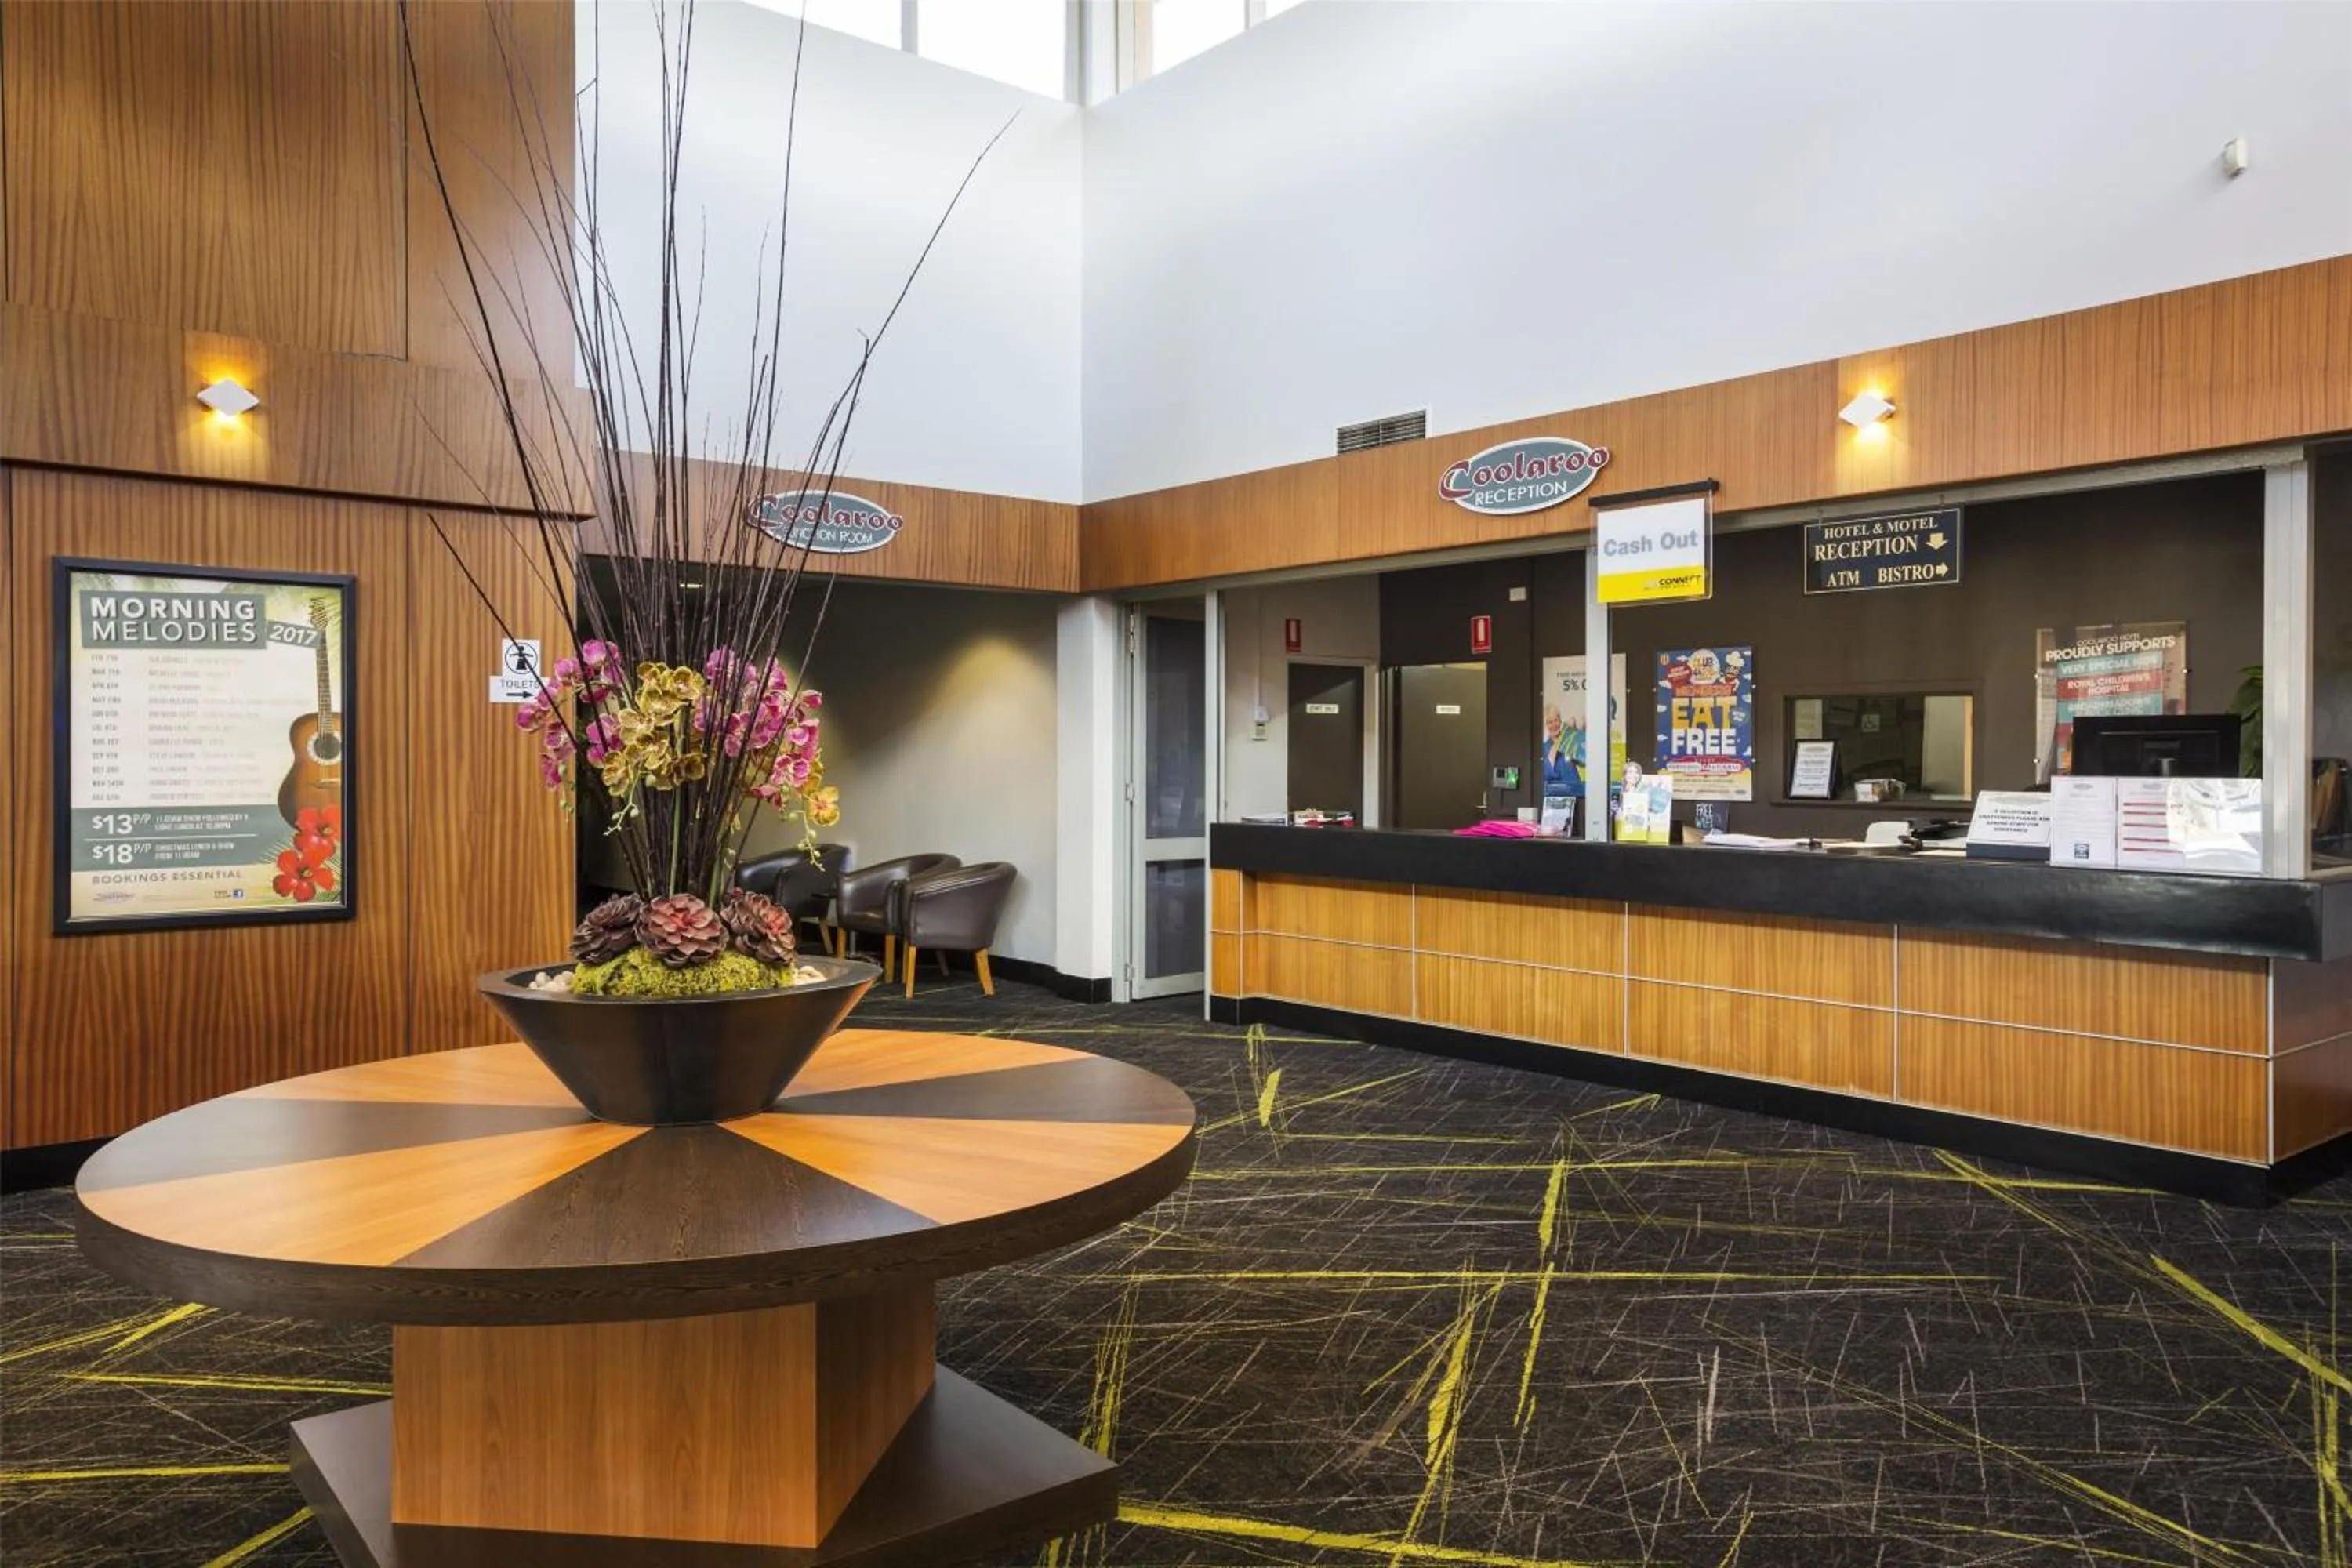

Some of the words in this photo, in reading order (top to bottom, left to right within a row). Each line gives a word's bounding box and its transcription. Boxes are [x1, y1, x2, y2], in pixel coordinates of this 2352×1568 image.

[1439, 446, 1609, 500] Coolaroo
[1475, 480, 1567, 506] RECEPTION
[840, 531, 873, 543] ROOM
[1824, 524, 1870, 539] HOTEL
[1872, 522, 1883, 534] &
[1887, 517, 1938, 533] MOTEL
[1603, 535, 1653, 557] Cash
[1660, 529, 1699, 550] Out
[1814, 535, 1918, 561] RECEPTION
[1827, 570, 1860, 587] ATM
[1878, 564, 1934, 583] BISTRO
[90, 597, 256, 620] MORNING
[92, 621, 257, 644] MELODIES
[269, 625, 318, 645] 2017
[2045, 644, 2103, 662] PROUDLY
[2107, 635, 2176, 655] SUPPORTS
[501, 679, 540, 688] TOILETS
[1671, 696, 1737, 729] EAT
[1671, 728, 1737, 755] FREE
[1696, 803, 1713, 818] FREE
[92, 814, 132, 835] $13
[132, 813, 151, 824] P/P
[92, 844, 133, 864] $18
[134, 843, 151, 854] P/P
[92, 873, 165, 884] BOOKINGS
[172, 869, 242, 881] ESSENTIAL
